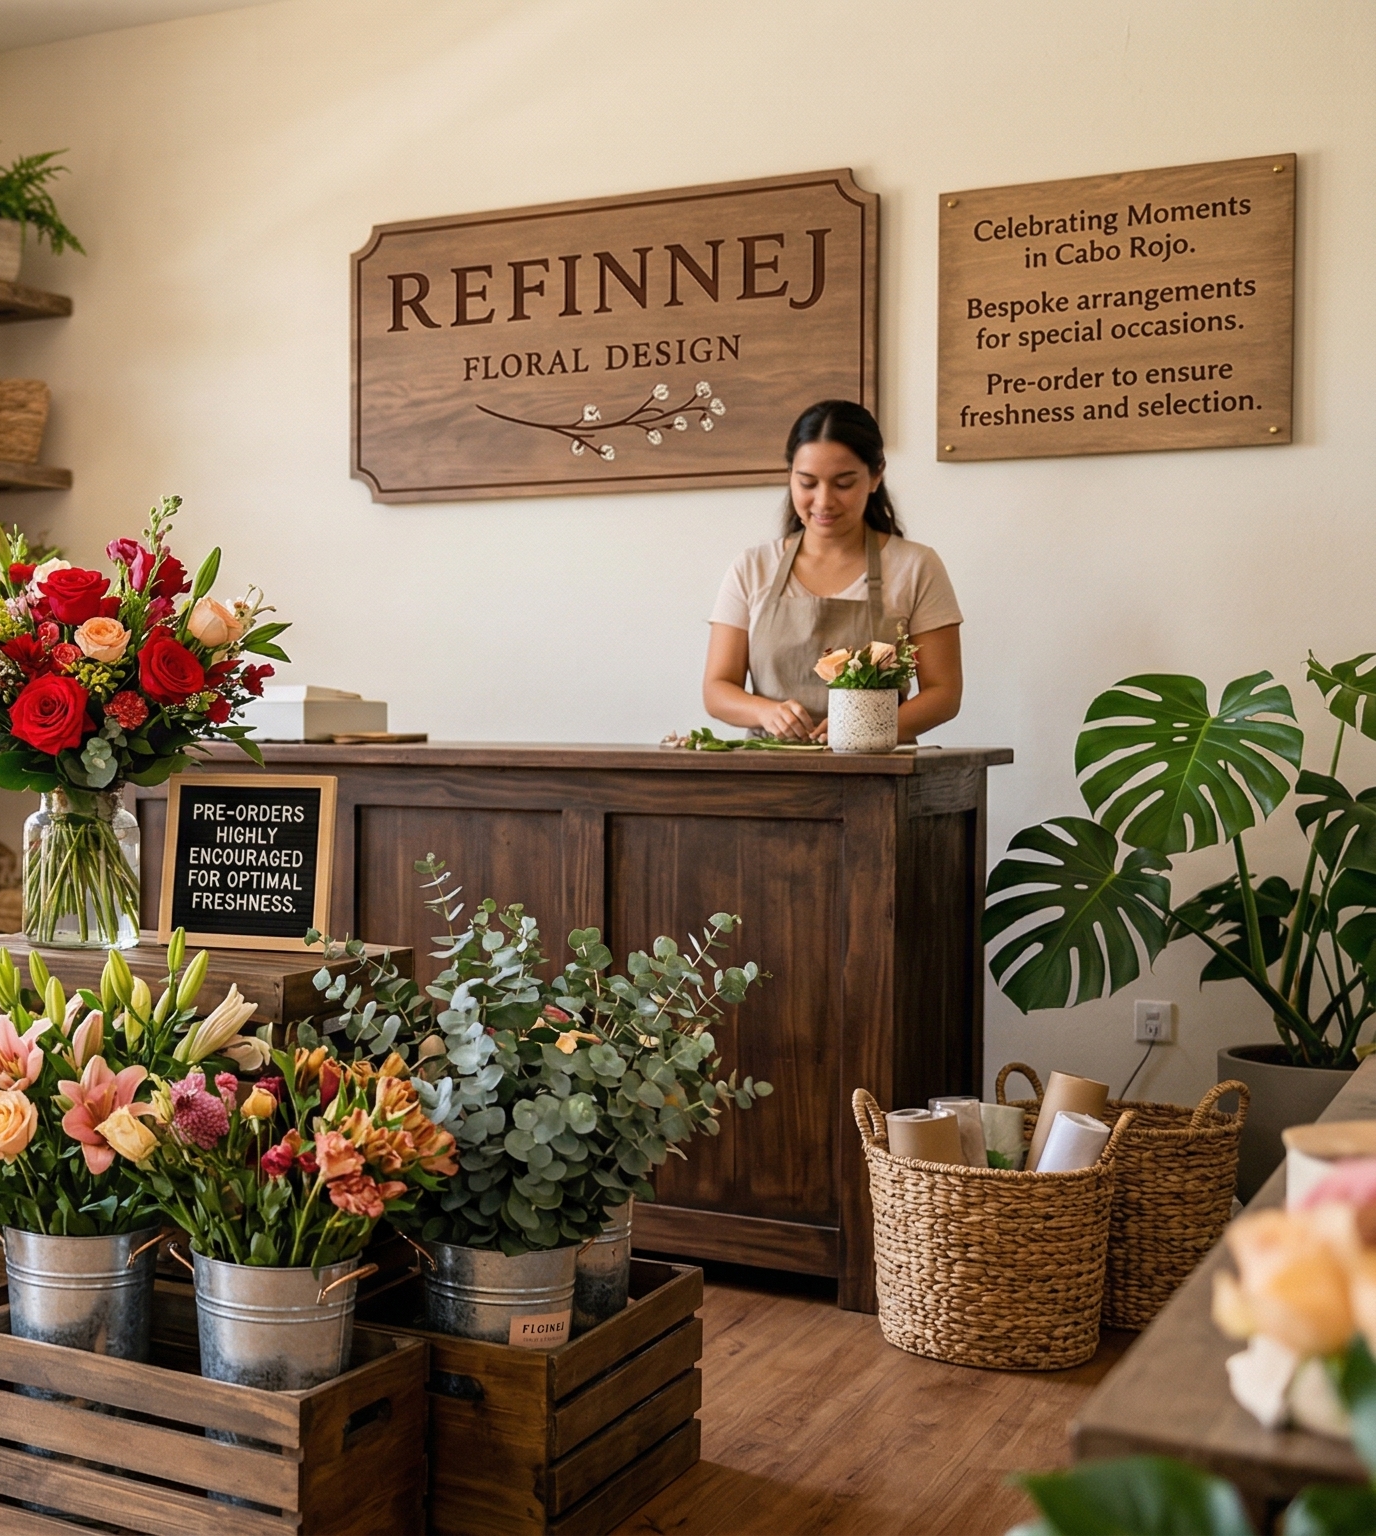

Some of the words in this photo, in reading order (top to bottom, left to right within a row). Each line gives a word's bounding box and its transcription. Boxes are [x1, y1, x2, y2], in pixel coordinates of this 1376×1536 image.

[974, 210, 1118, 242] Celebrating
[1127, 197, 1251, 226] Moments
[1024, 248, 1047, 268] in
[1055, 240, 1121, 266] Cabo
[1129, 233, 1196, 262] Rojo.
[386, 228, 832, 332] REFINNEJ
[967, 291, 1069, 322] Bespoke
[1077, 277, 1256, 310] arrangements
[976, 328, 1011, 349] for
[1018, 318, 1102, 352] special
[1111, 312, 1245, 340] occasions.
[463, 348, 589, 381] FLORAL
[605, 334, 742, 370] DESIGN
[986, 368, 1105, 395] Pre-order
[1112, 366, 1138, 387] to
[1145, 362, 1233, 384] ensure
[960, 403, 1075, 427] freshness
[1082, 396, 1129, 420] and
[1138, 390, 1262, 417] selection.
[193, 803, 304, 822] PRE-ORDERS
[216, 826, 277, 843] HIGHLY
[189, 847, 302, 867] ENCOURAGED
[188, 870, 219, 887] FOR
[227, 871, 302, 890] OPTIMAL
[192, 892, 296, 913] FRESHNESS.
